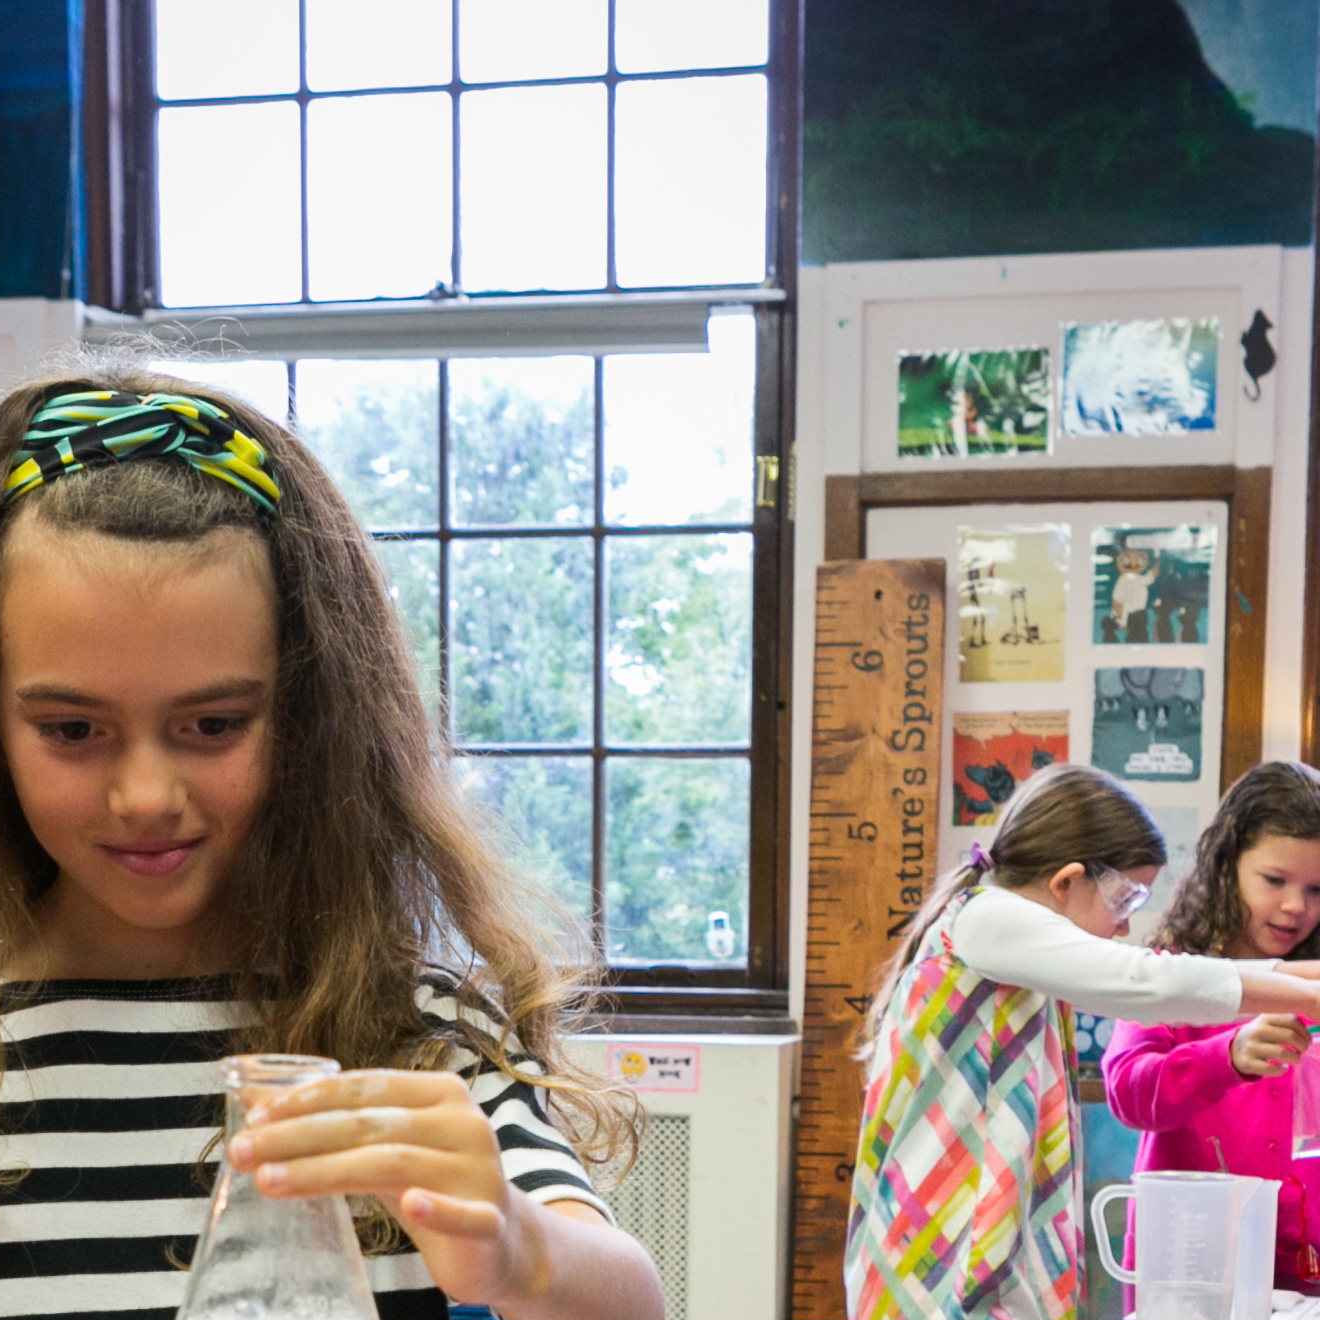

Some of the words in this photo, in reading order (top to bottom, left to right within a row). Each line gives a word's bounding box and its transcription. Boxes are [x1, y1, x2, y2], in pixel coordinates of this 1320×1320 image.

[851, 649, 884, 673] 6
[890, 592, 934, 753] Sprouts
[848, 820, 878, 843] 5
[886, 766, 928, 941] Nature's
[844, 994, 870, 1015] 4
